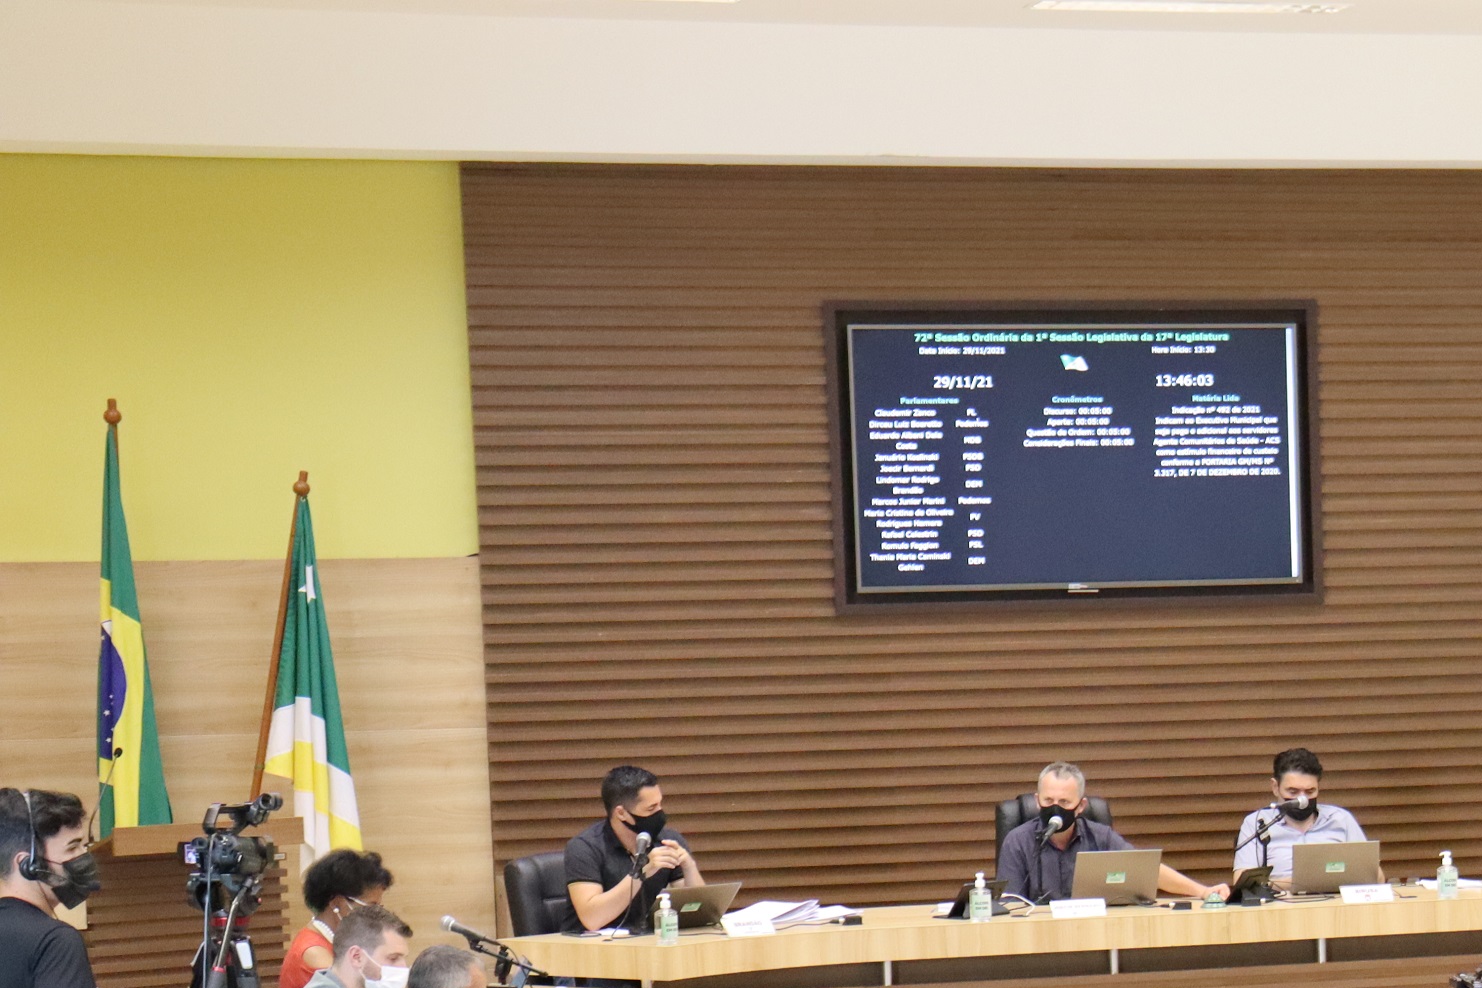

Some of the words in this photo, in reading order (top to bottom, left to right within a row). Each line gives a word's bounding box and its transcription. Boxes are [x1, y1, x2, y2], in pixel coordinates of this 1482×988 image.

[934, 333, 970, 342] Sessão
[971, 333, 1019, 342] Ordinária
[1020, 333, 1034, 342] da
[1049, 333, 1085, 341] Sessão
[1086, 333, 1140, 343] Legislativa
[1140, 333, 1154, 341] da
[1175, 333, 1230, 343] Legislatura
[933, 375, 994, 389] 29/11/21
[1155, 374, 1214, 387] 13:46:03
[1051, 395, 1104, 403] Cronômetros
[1192, 394, 1222, 402] Matéria
